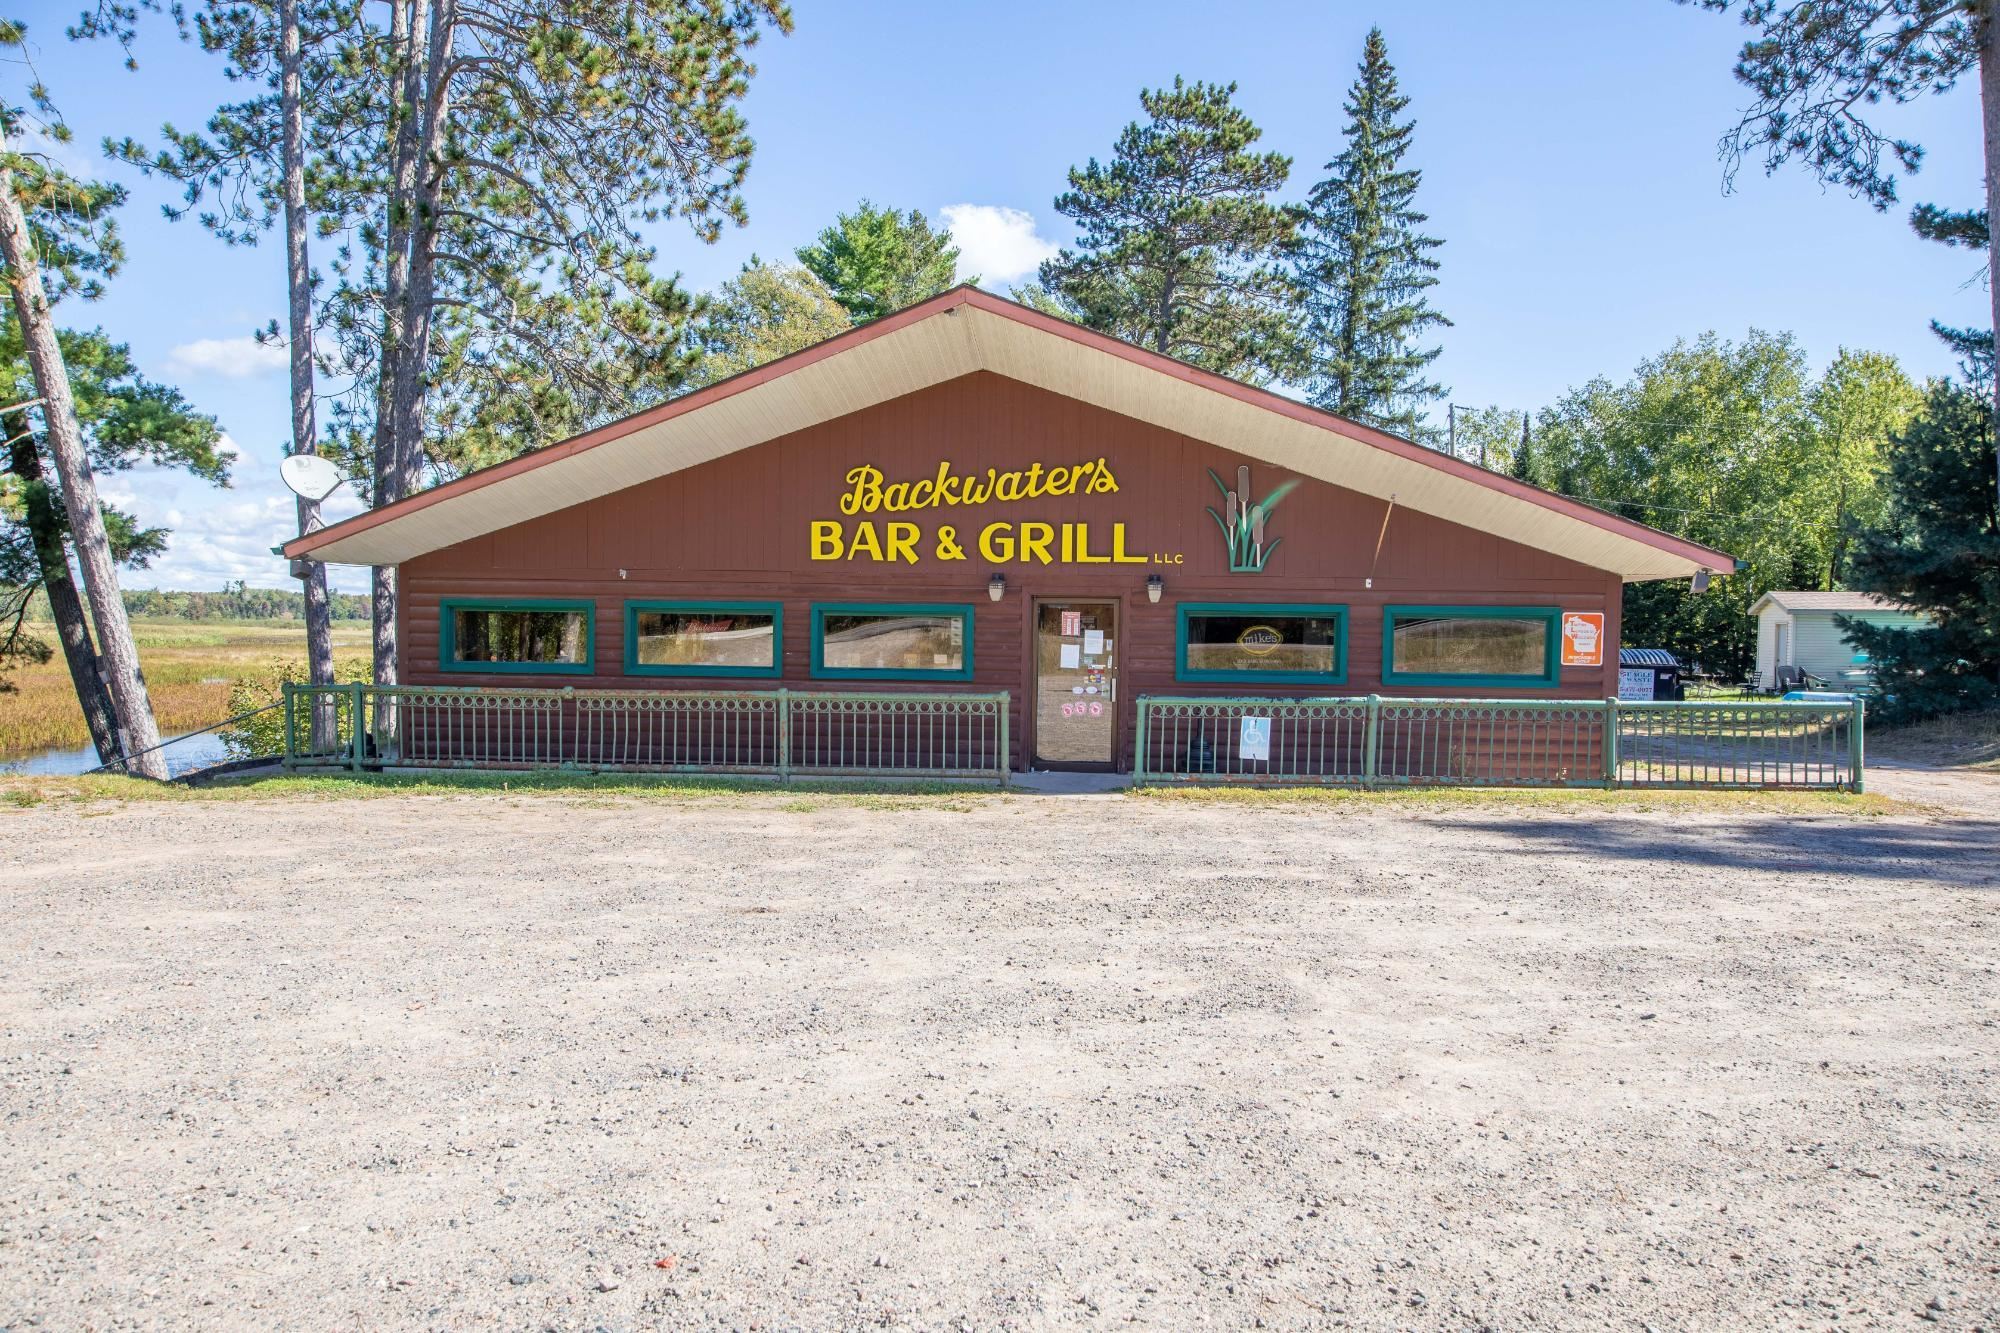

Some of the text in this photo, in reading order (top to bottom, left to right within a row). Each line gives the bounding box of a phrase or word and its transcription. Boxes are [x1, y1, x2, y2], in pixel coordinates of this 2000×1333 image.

[839, 457, 1120, 516] Backwaters
[810, 520, 1184, 566] BAR & GRILL LLC
